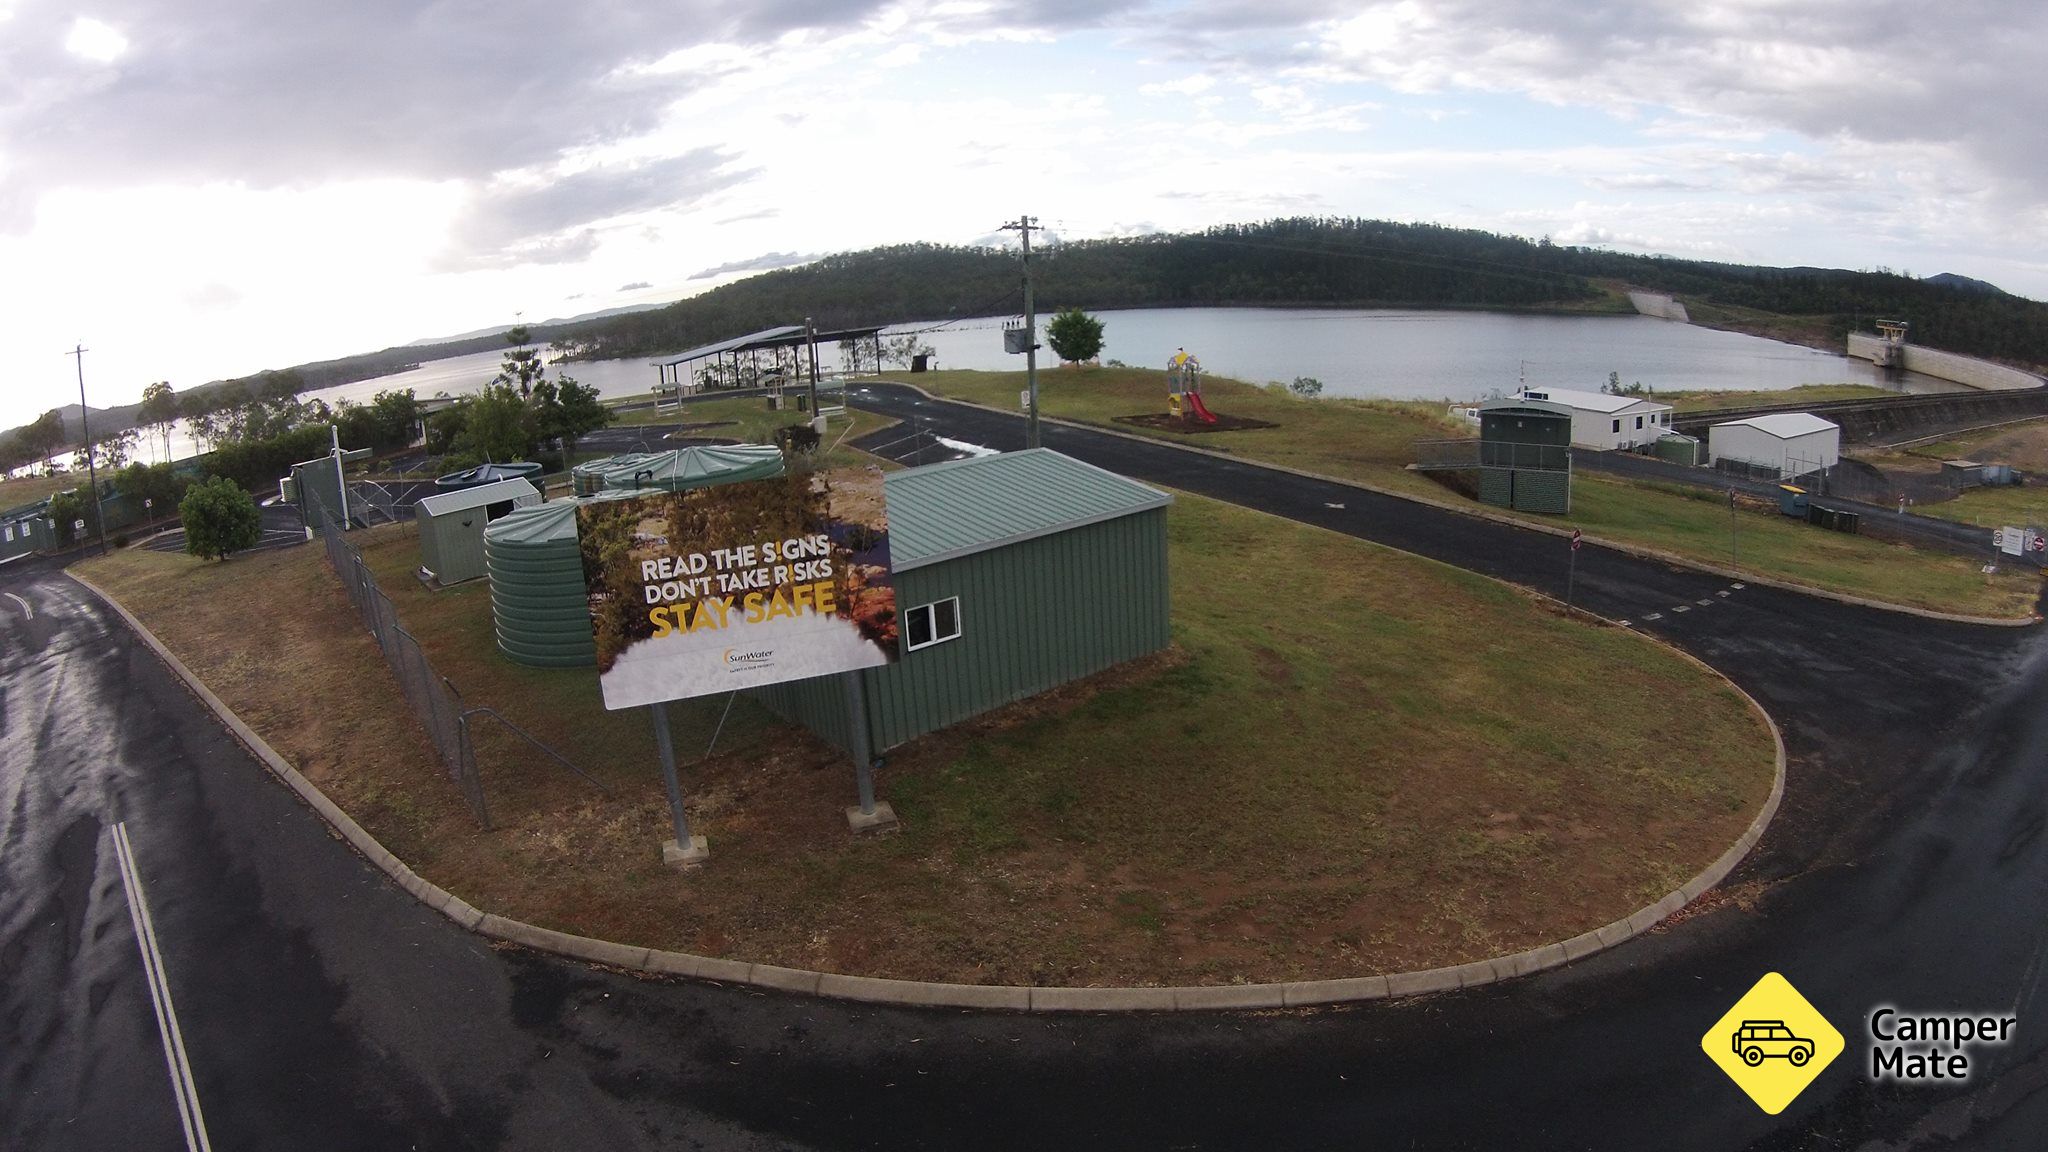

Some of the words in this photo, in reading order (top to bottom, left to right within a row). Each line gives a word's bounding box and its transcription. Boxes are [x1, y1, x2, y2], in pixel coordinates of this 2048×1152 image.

[642, 553, 708, 581] READ
[712, 545, 757, 570] THE
[645, 577, 711, 604] DON'T
[716, 568, 770, 592] TAKE
[649, 596, 734, 638] STAY
[744, 581, 837, 624] SAFE
